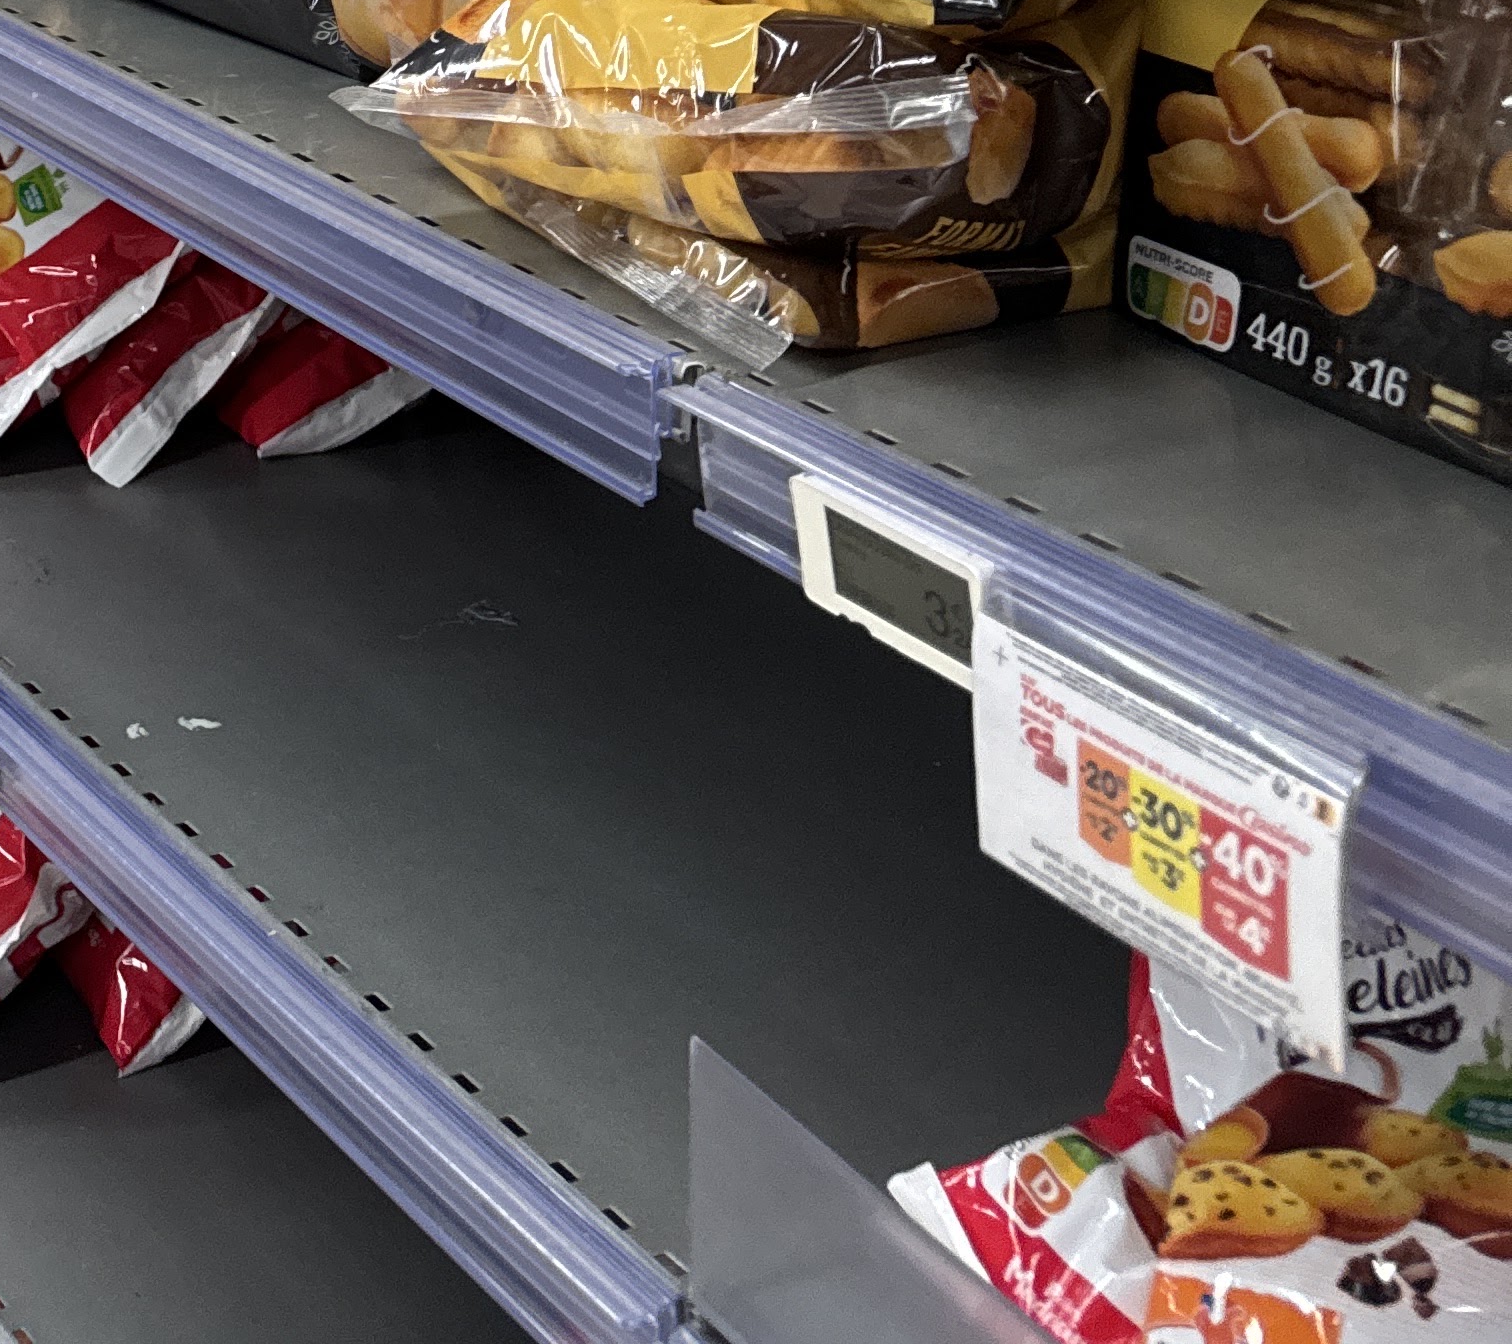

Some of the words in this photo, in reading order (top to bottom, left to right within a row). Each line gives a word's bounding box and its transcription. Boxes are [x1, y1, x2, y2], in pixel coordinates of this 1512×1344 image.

[1134, 241, 1214, 285] NUTRI-SCORE
[1245, 312, 1310, 368] 440
[1313, 355, 1333, 387] g
[1346, 358, 1410, 409] x16
[1020, 683, 1065, 721] TOUS
[1131, 784, 1197, 843] -30%
[1200, 830, 1287, 899] -40%
